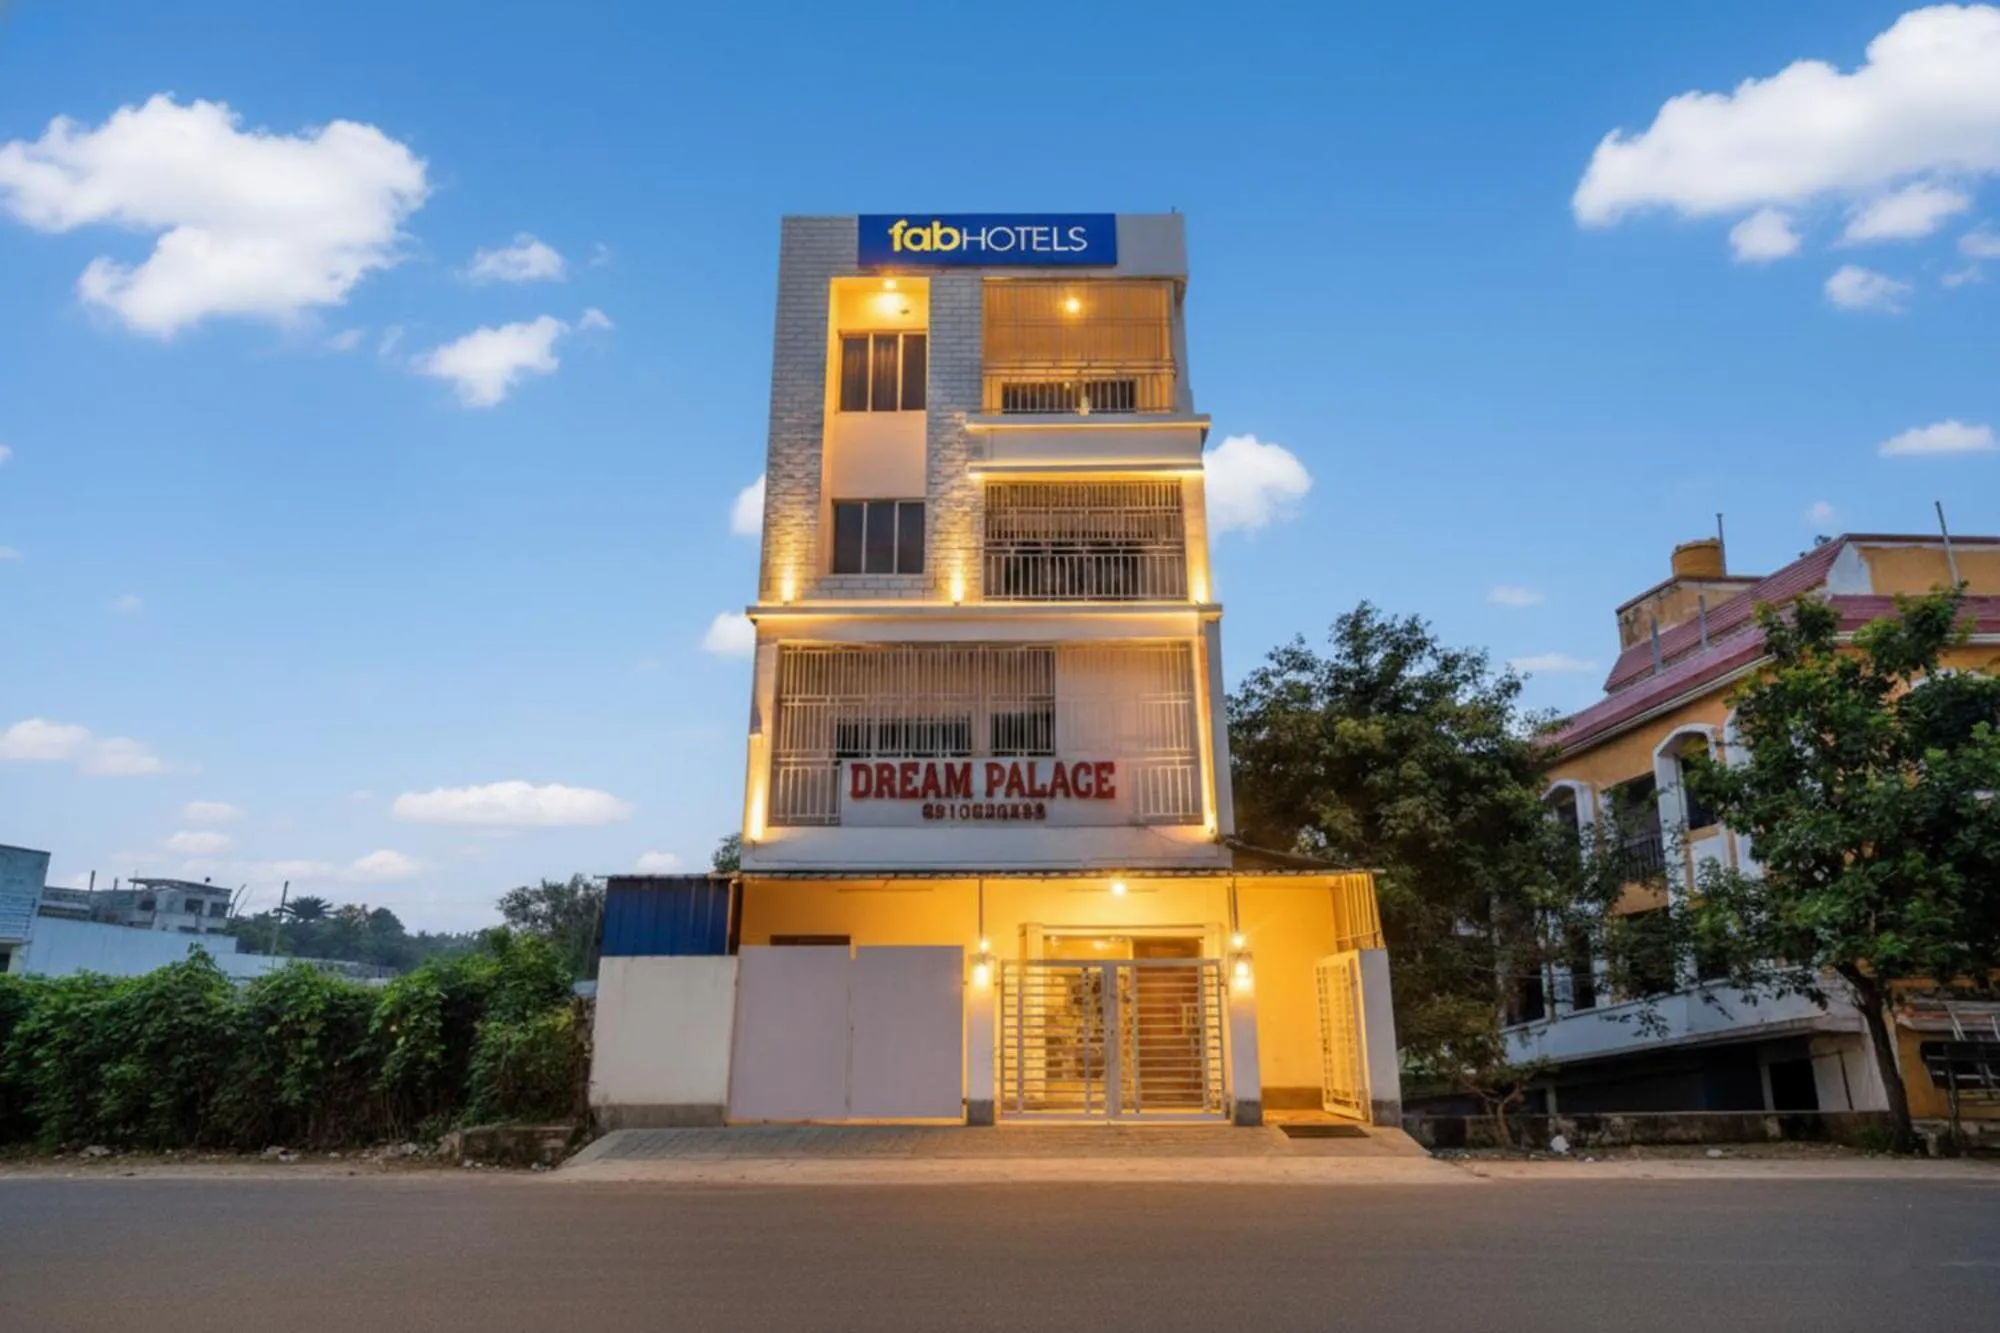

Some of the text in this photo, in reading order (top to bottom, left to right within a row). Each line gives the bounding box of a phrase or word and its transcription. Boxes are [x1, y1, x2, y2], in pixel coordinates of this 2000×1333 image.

[888, 219, 1088, 252] fabHOTELS
[850, 761, 1116, 799] DREAM PALACE
